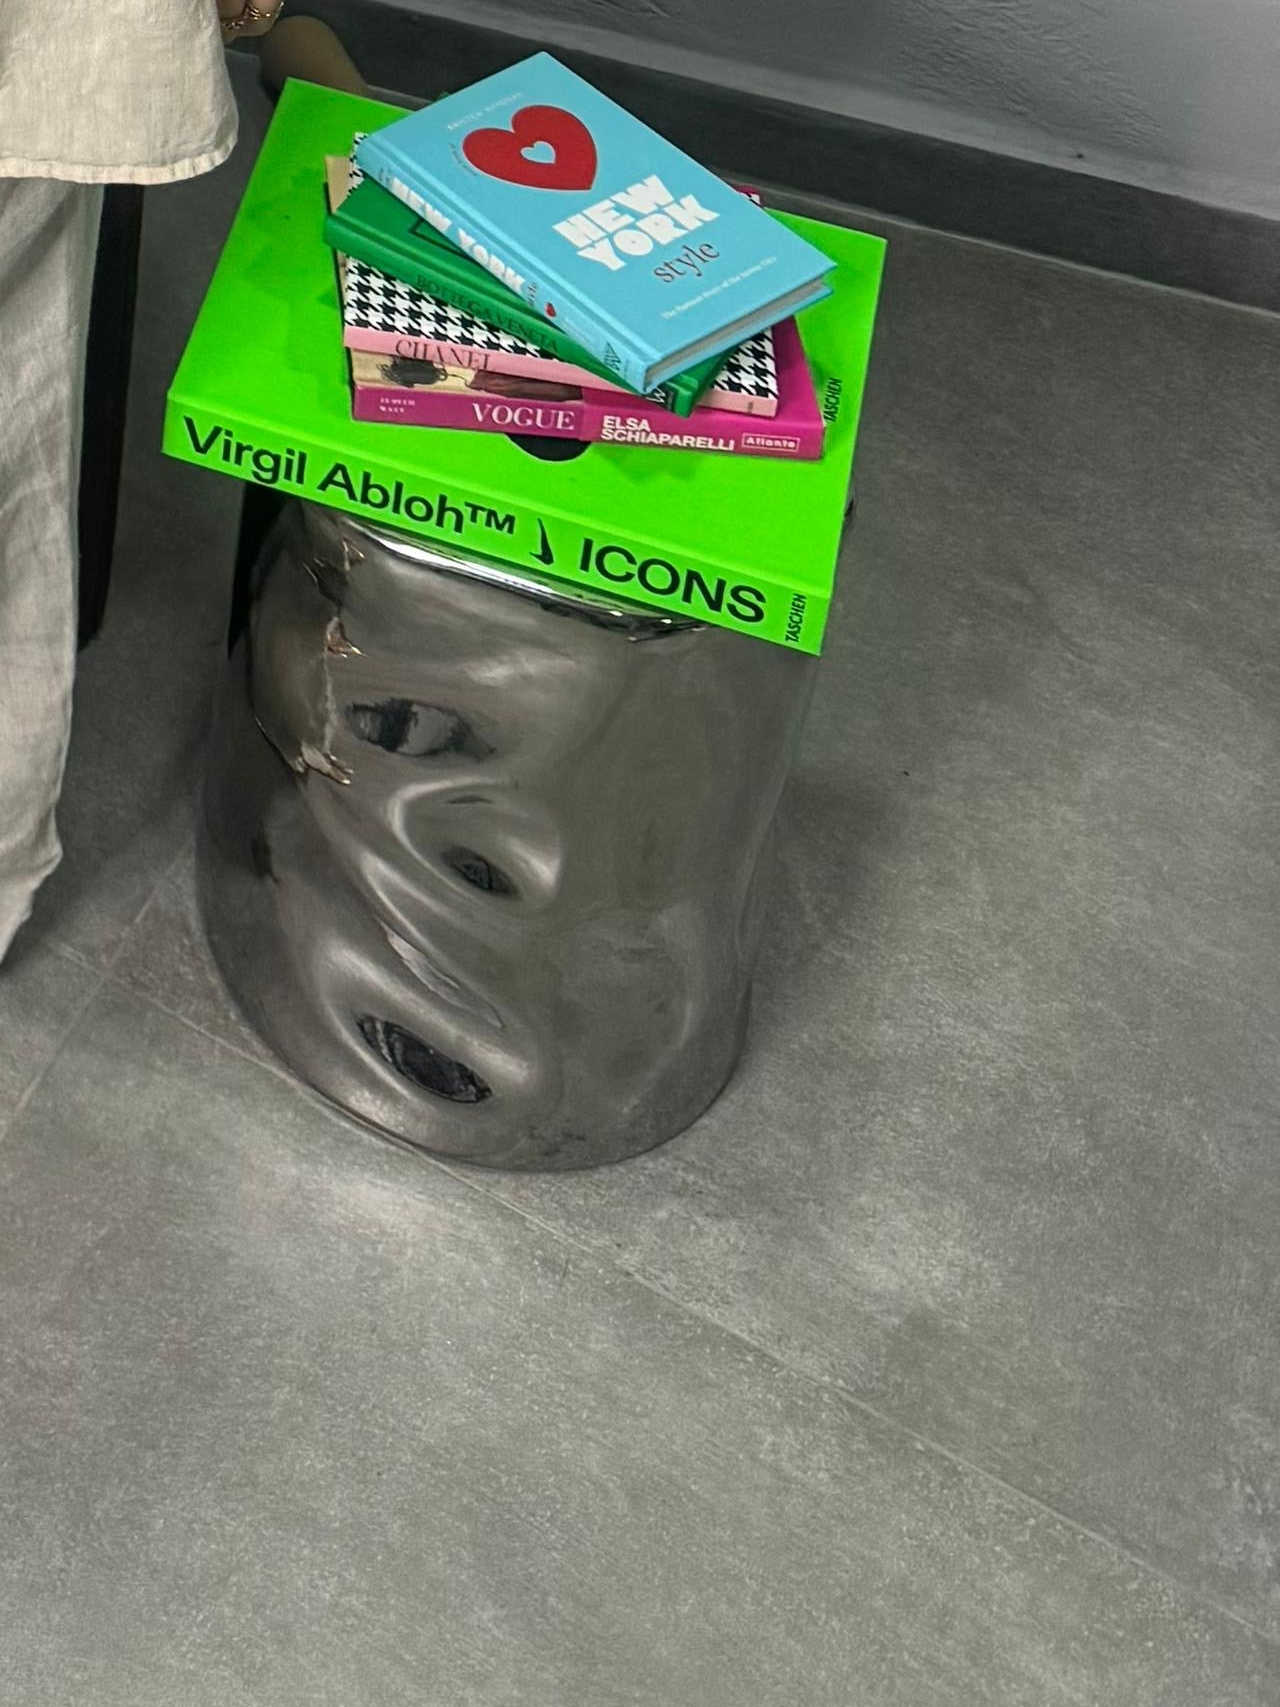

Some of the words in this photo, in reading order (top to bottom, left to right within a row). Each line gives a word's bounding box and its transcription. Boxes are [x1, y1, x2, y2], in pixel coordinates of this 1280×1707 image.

[391, 177, 452, 232] NEW
[457, 227, 525, 292] YORK
[552, 174, 674, 248] NEW
[576, 194, 720, 271] YORK
[653, 242, 720, 283] style
[416, 275, 492, 322] BOTTEGA
[496, 309, 560, 354] VENETA
[472, 402, 575, 431] VOGUE
[602, 415, 651, 432] ELSA
[823, 377, 842, 423] TASCHEN
[184, 416, 307, 484] Virgil
[601, 428, 736, 451] SCHIAPARELLI
[579, 537, 767, 623] ICONS
[785, 593, 807, 642] TASCHEN
